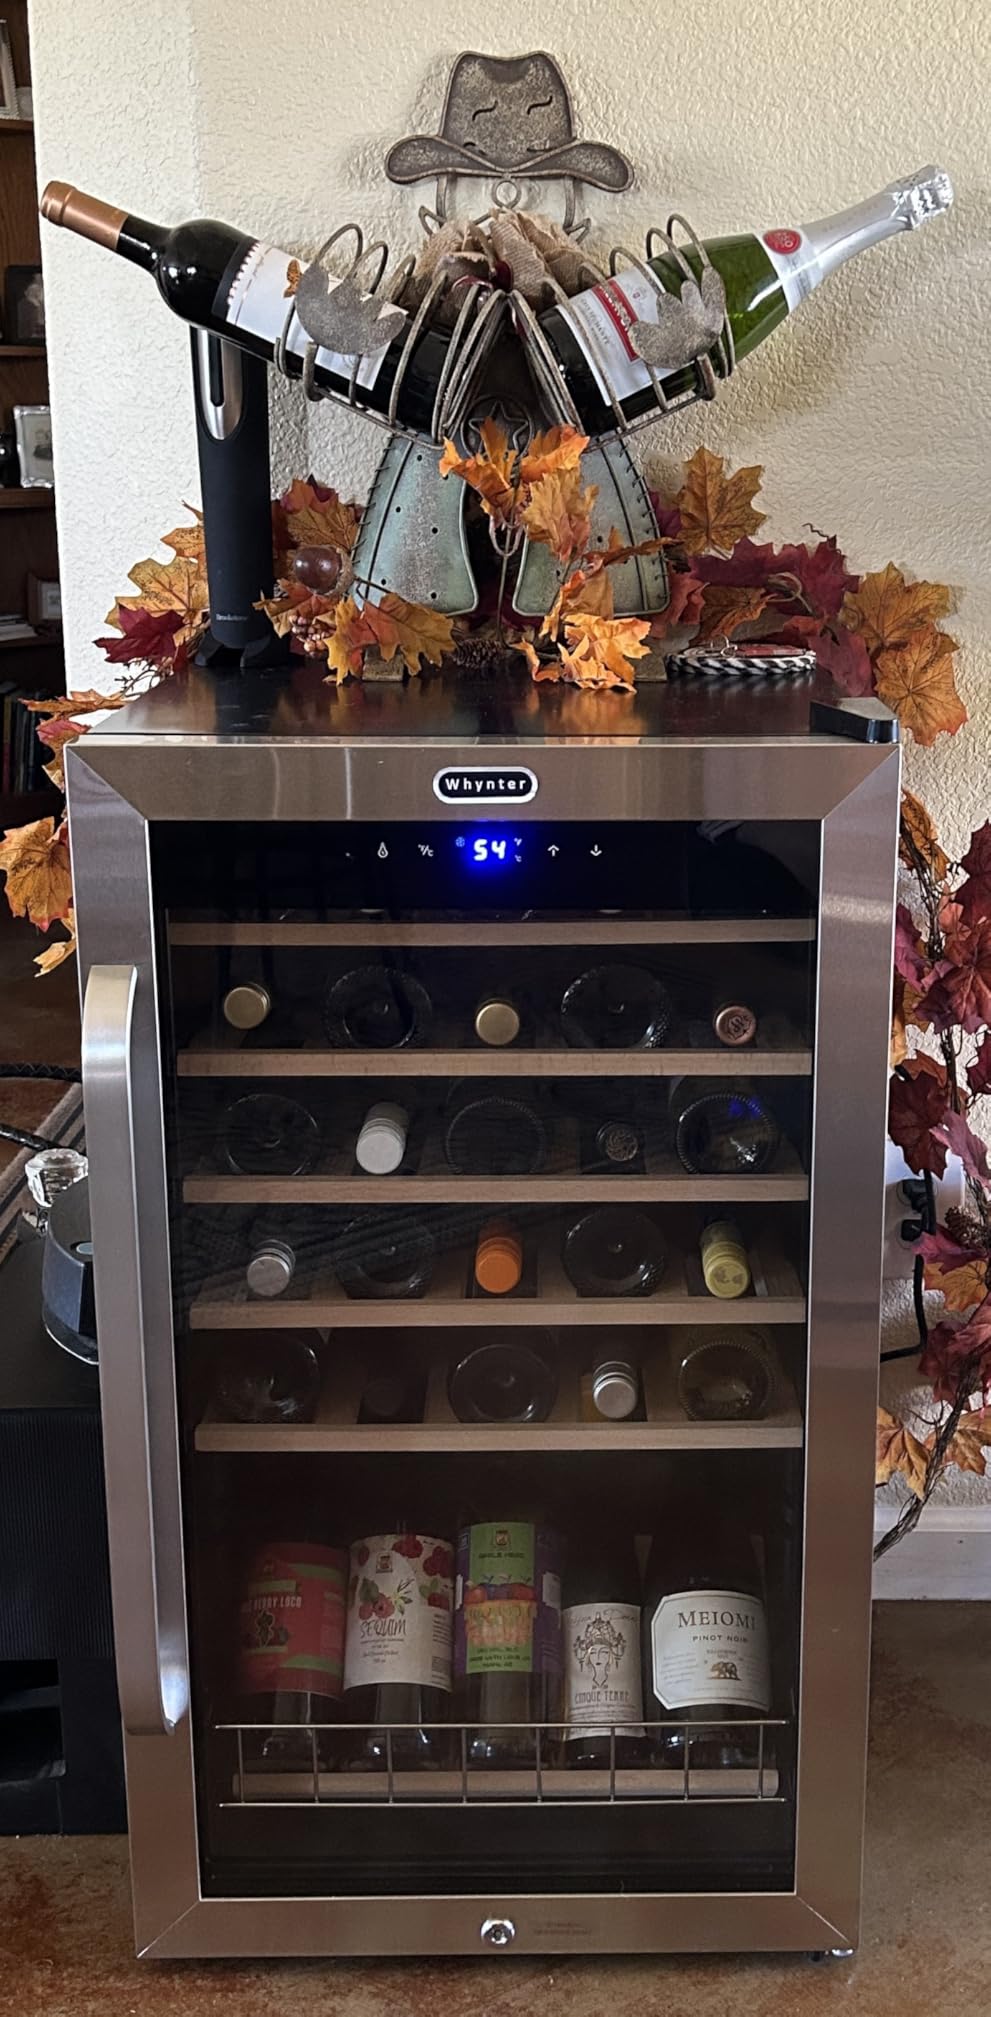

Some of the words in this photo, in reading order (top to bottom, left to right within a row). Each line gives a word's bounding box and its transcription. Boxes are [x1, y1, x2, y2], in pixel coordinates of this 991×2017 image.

[445, 777, 526, 793] Whynter
[473, 838, 506, 862] 54
[280, 1596, 302, 1609] LOCO
[677, 1610, 756, 1631] MEIOMI
[693, 1634, 723, 1642] PINOT
[727, 1635, 748, 1643] NOIR
